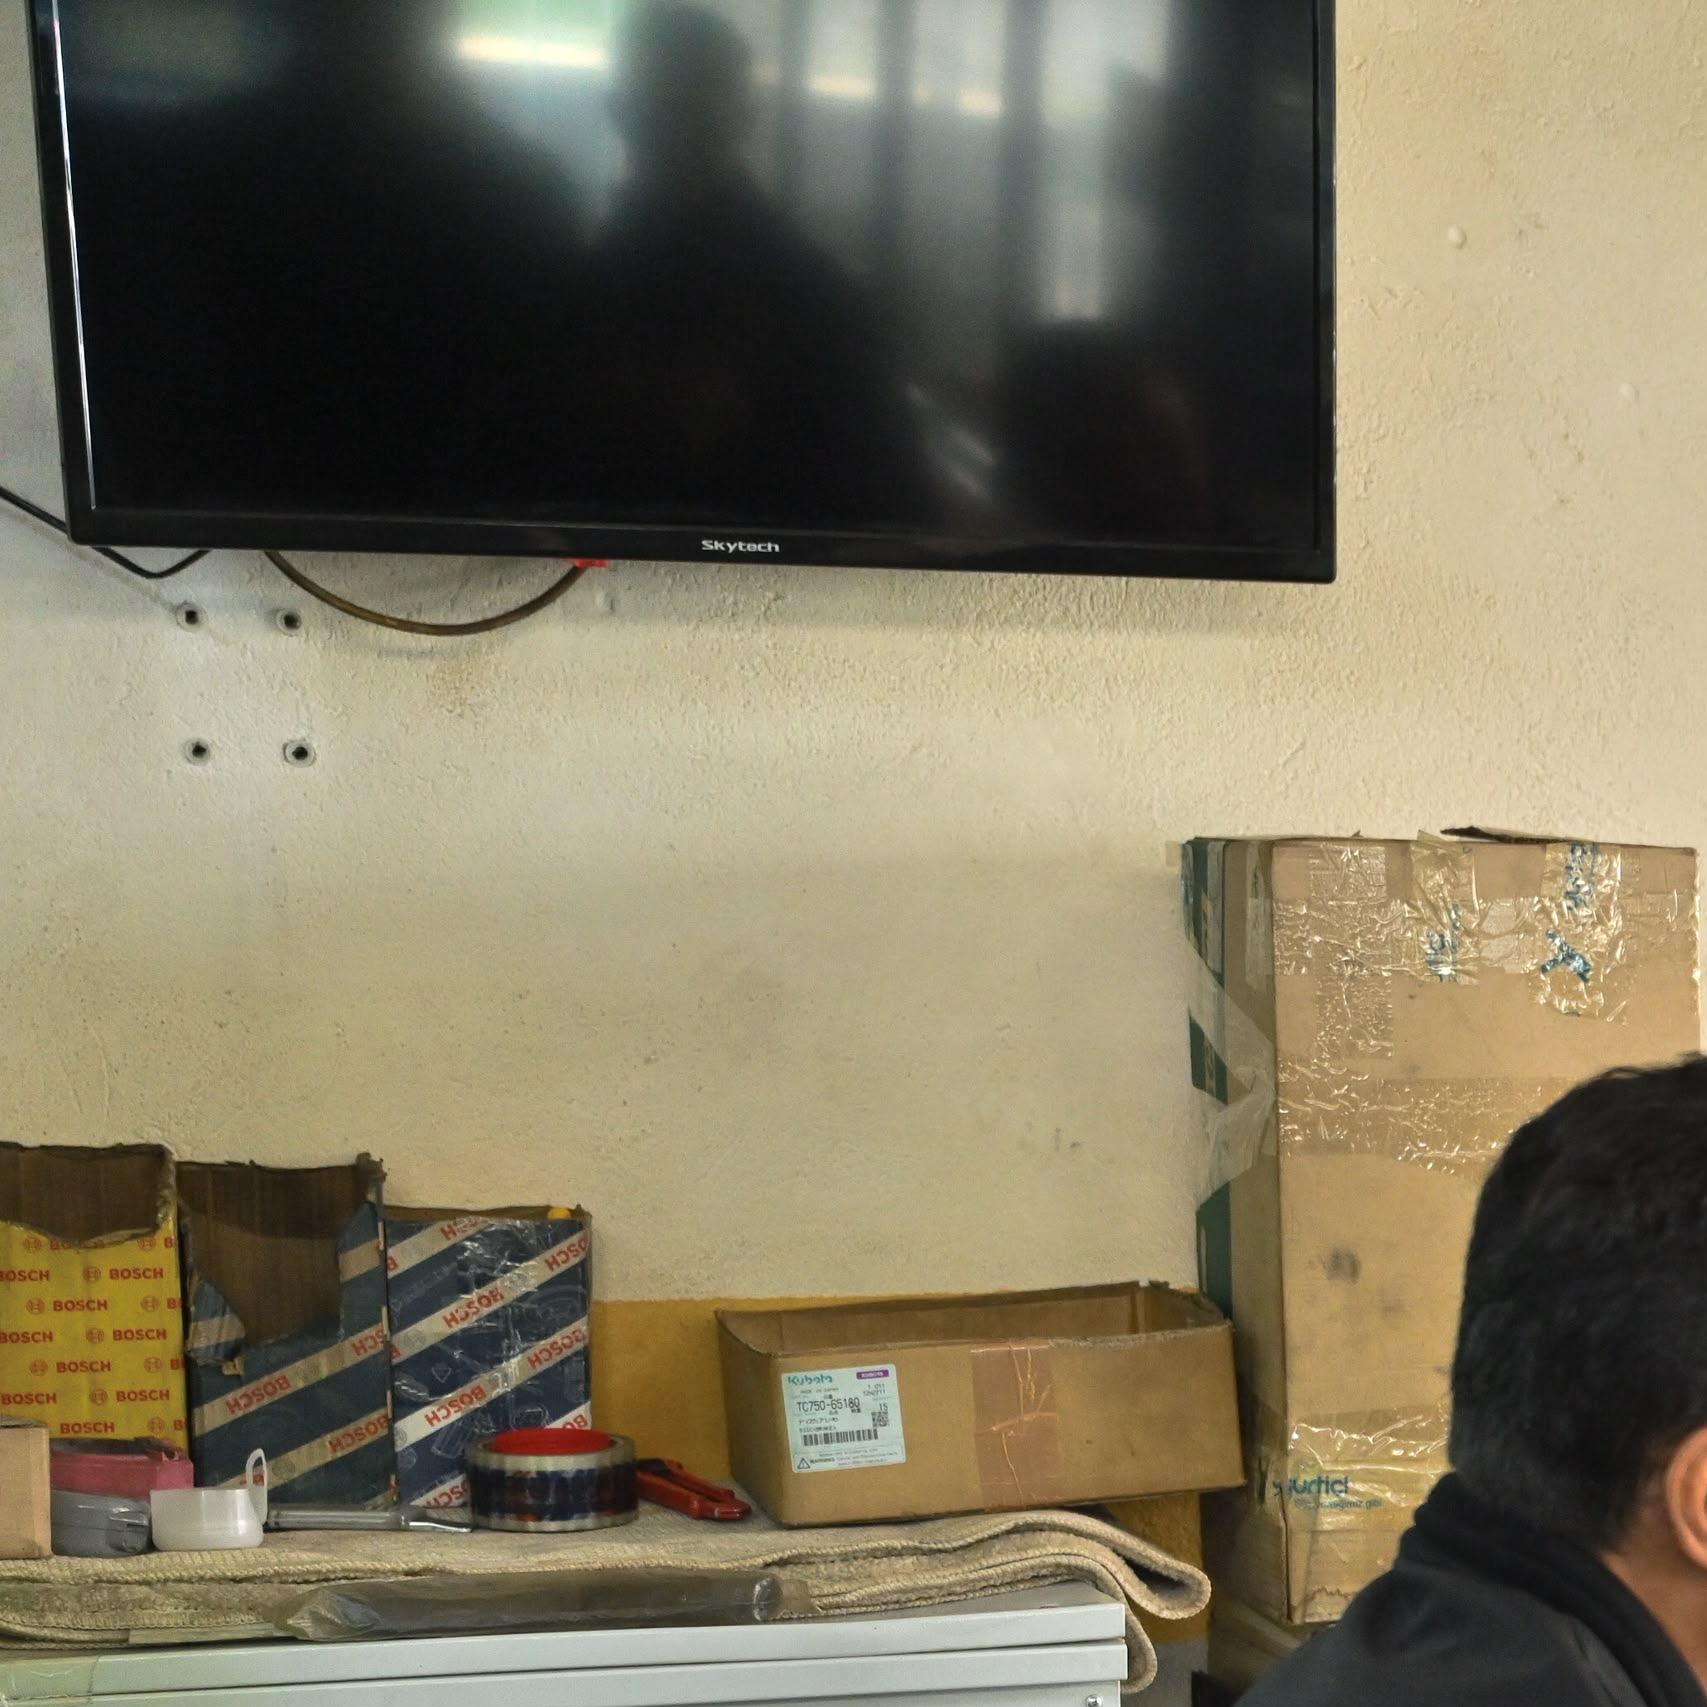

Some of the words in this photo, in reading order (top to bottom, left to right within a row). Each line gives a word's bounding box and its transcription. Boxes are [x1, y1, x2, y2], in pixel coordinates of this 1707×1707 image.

[701, 539, 780, 553] Skytech
[109, 1267, 164, 1281] BOSCH
[53, 1299, 108, 1312] BOSCH
[112, 1328, 167, 1342] BOSCH
[527, 1326, 586, 1370] BOSCH
[56, 1360, 112, 1373] BOSCH
[787, 1374, 833, 1386] Kubota
[1, 1392, 57, 1405] BOSCH
[116, 1389, 170, 1402] BOSCH
[225, 1374, 291, 1414] BOSCH
[424, 1384, 487, 1428] BOSCH
[60, 1421, 115, 1435] BOSCH
